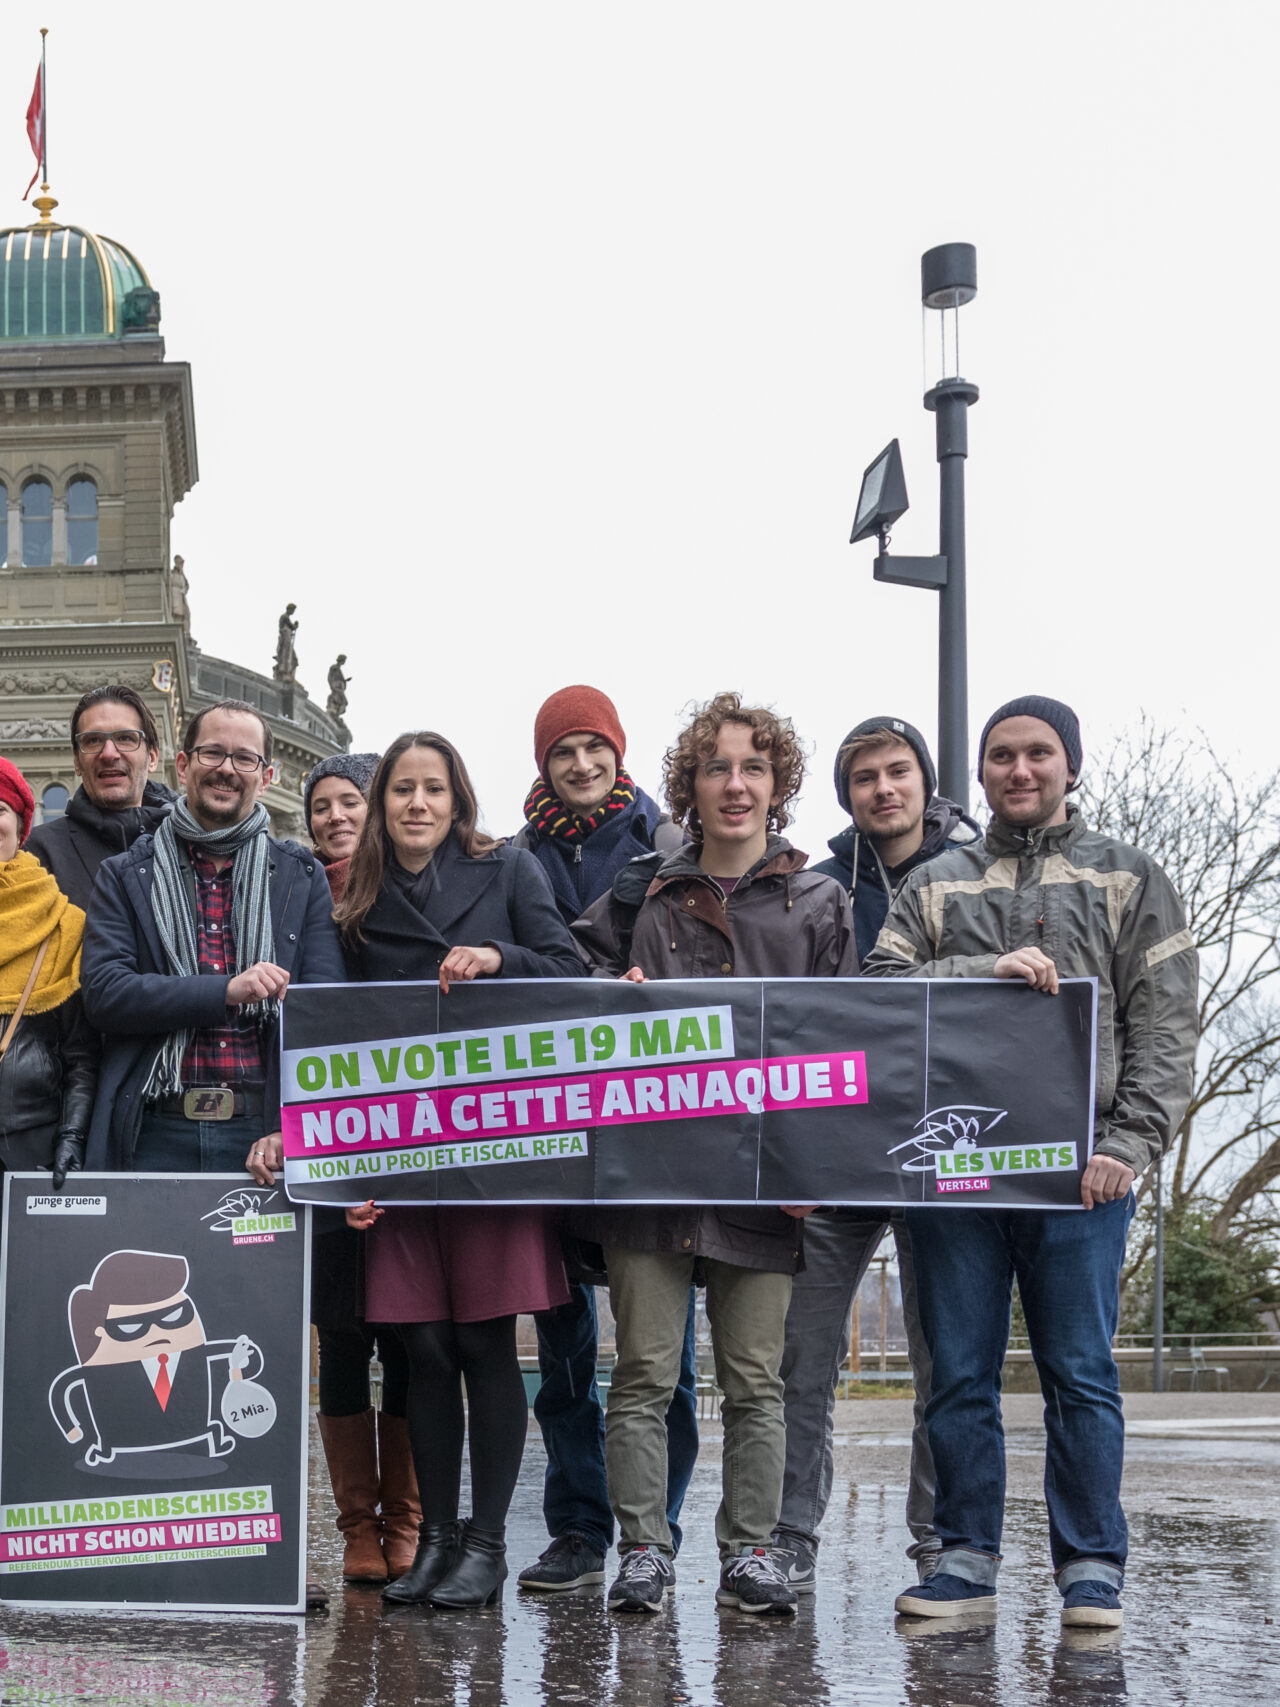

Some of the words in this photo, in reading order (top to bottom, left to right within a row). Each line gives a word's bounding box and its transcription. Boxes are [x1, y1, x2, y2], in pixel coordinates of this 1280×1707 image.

[296, 1051, 361, 1092] ON
[370, 1037, 491, 1084] VOTE
[503, 1030, 557, 1071] LE
[567, 1024, 616, 1063] 19
[629, 1014, 722, 1058] MAI
[301, 1103, 400, 1148] NON
[411, 1093, 443, 1137] À
[451, 1082, 592, 1132] CETTE
[600, 1061, 833, 1118] ARNAQUE
[307, 1159, 351, 1180] NON
[354, 1155, 383, 1175] AU
[386, 1147, 457, 1173] PROJET
[461, 1142, 528, 1164] FISCAL
[532, 1135, 584, 1157] RFFA
[939, 1151, 984, 1175] LES
[988, 1146, 1074, 1172] VERTS
[938, 1178, 988, 1191] VERTS.CH
[65, 1196, 101, 1209] gruene
[234, 1213, 294, 1233] GRÜNE
[233, 1234, 274, 1244] GRUENE.CH
[230, 1411, 240, 1423] 2
[241, 1403, 268, 1419] Mia.
[6, 1490, 268, 1528] MILLIARDENBSCHISS?
[7, 1533, 80, 1556] NICHT
[85, 1526, 166, 1551] SCHON
[171, 1518, 277, 1545] WIEDER!
[8, 1560, 71, 1572] REFERENDUM
[73, 1553, 154, 1567] STEUERVORLAGE:
[155, 1551, 179, 1563] JETZT
[181, 1545, 265, 1560] UNTERSCHREIBEN
